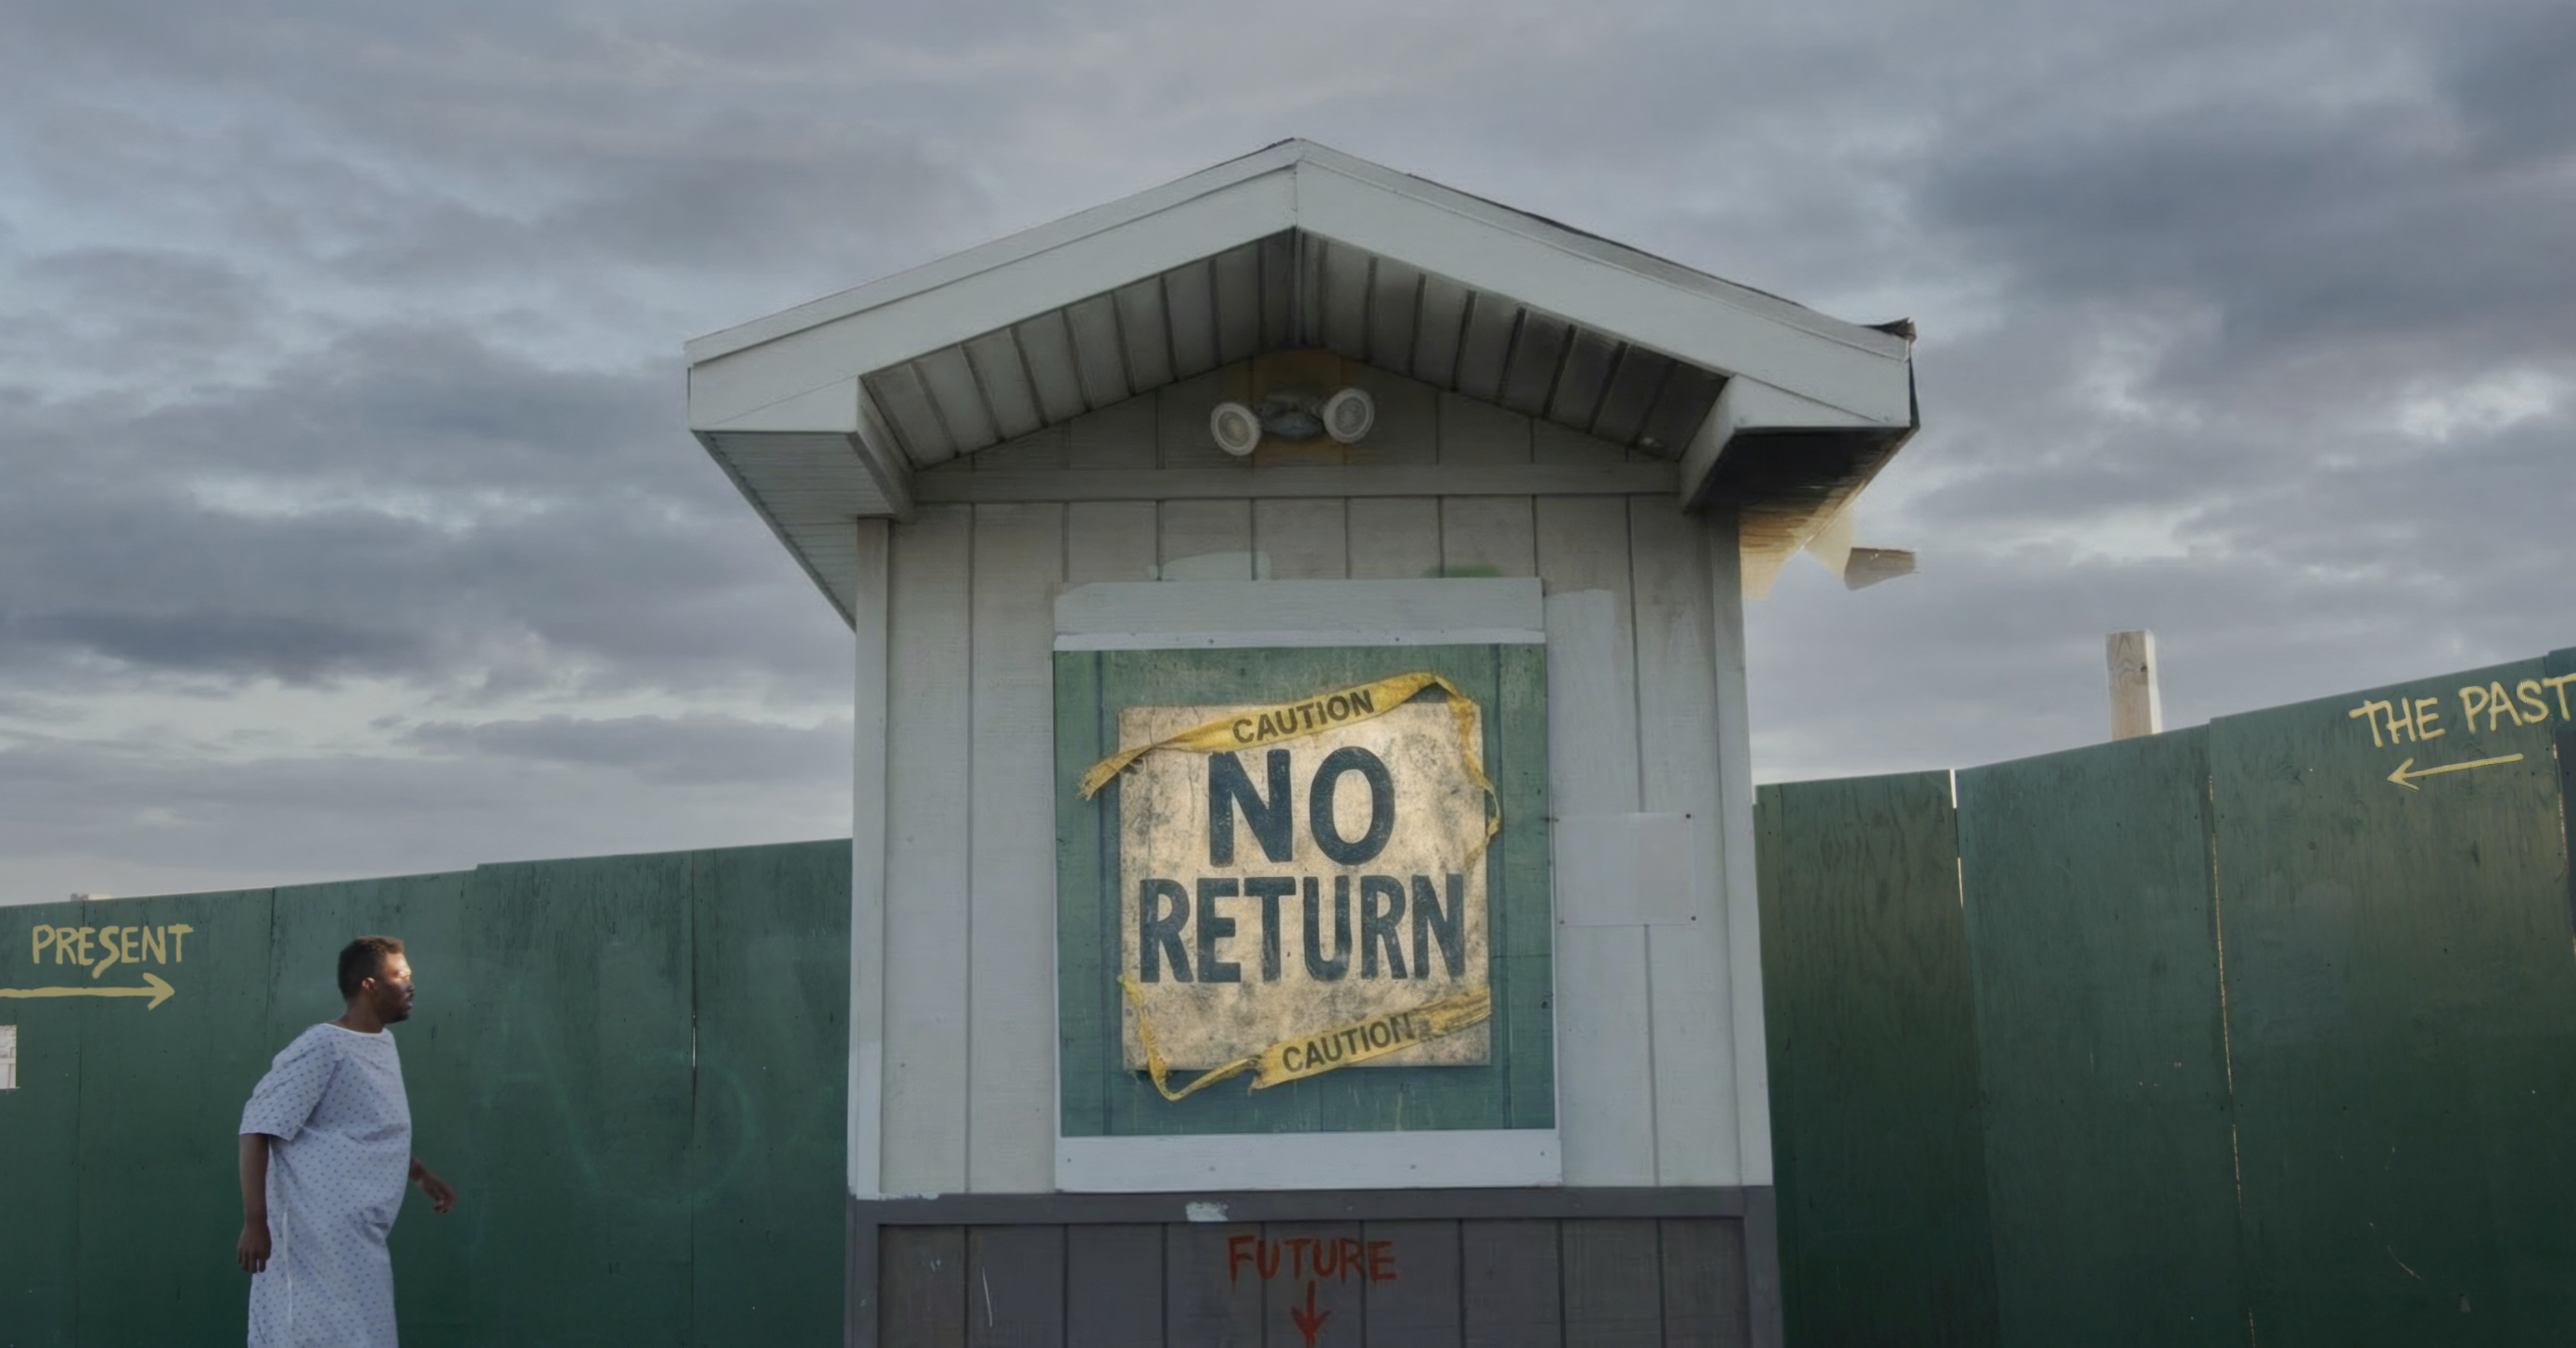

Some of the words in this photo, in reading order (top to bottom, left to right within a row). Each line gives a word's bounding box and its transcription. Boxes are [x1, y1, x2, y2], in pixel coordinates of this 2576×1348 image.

[1232, 689, 1375, 744] CAUTION
[2348, 696, 2446, 748] THE
[2458, 673, 2576, 733] PAST
[1208, 745, 1396, 868] NO
[32, 923, 194, 979] PRESENT
[1140, 874, 1465, 983] RETURN
[1282, 1014, 1415, 1074] CAUTION
[1228, 1236, 1397, 1286] FUTURE
